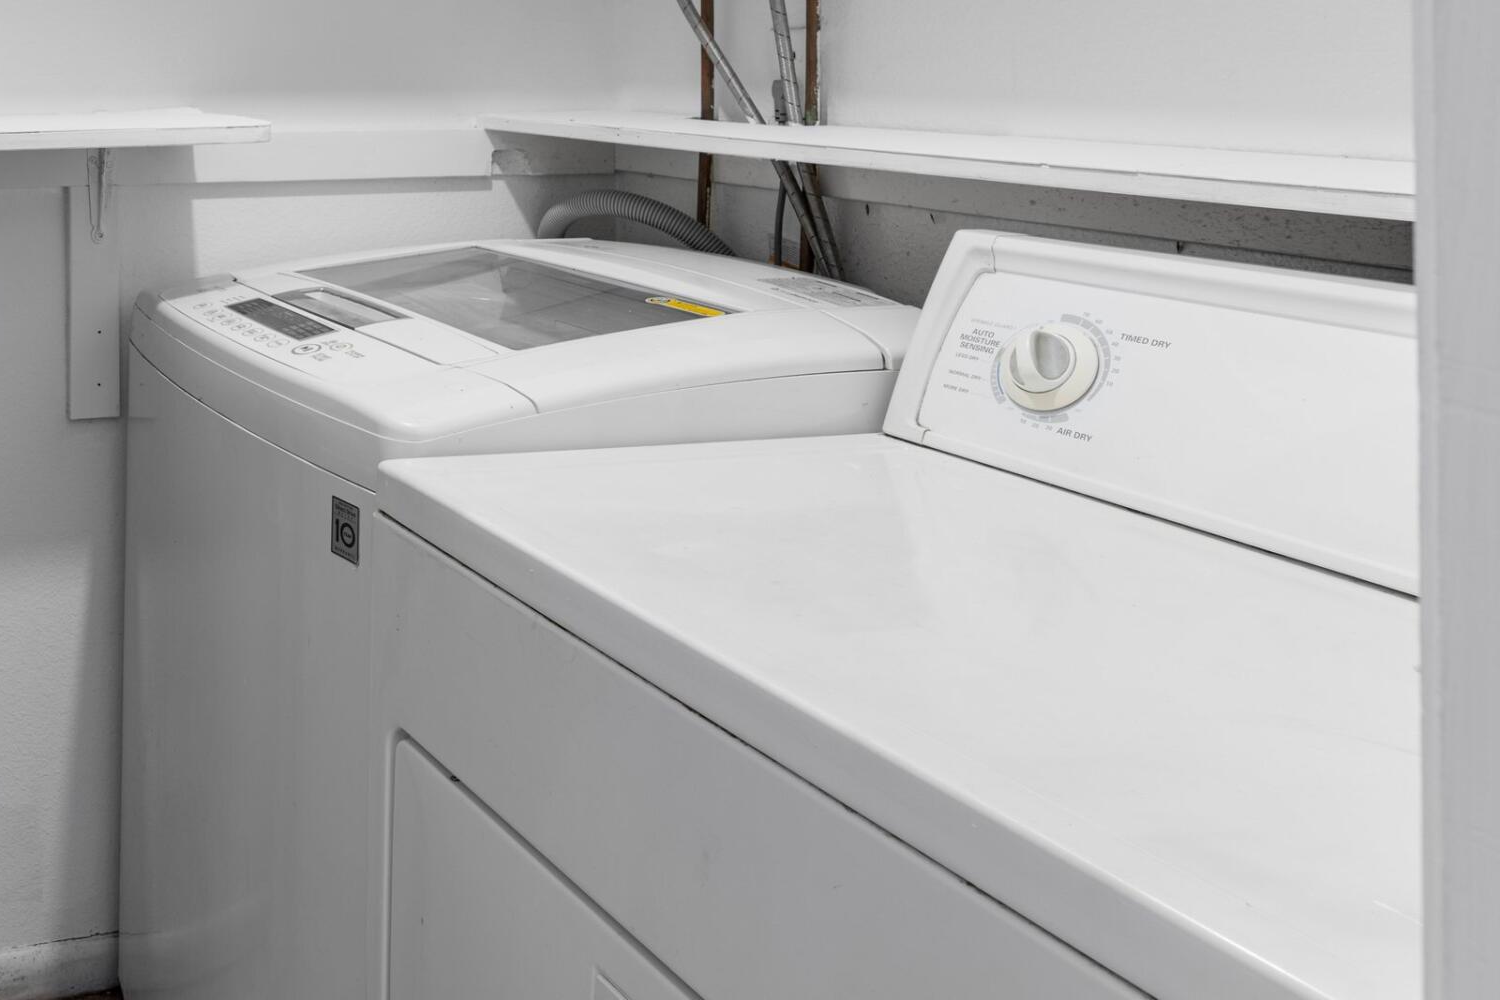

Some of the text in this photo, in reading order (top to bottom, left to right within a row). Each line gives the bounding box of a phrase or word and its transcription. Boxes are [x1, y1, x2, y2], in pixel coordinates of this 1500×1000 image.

[960, 333, 1001, 347] MOISTURE
[972, 328, 995, 338] AUTO
[959, 341, 995, 354] SENSING
[1120, 333, 1172, 349] TIMED DRY
[1056, 427, 1092, 442] AIR DRY
[335, 519, 355, 548] 10
